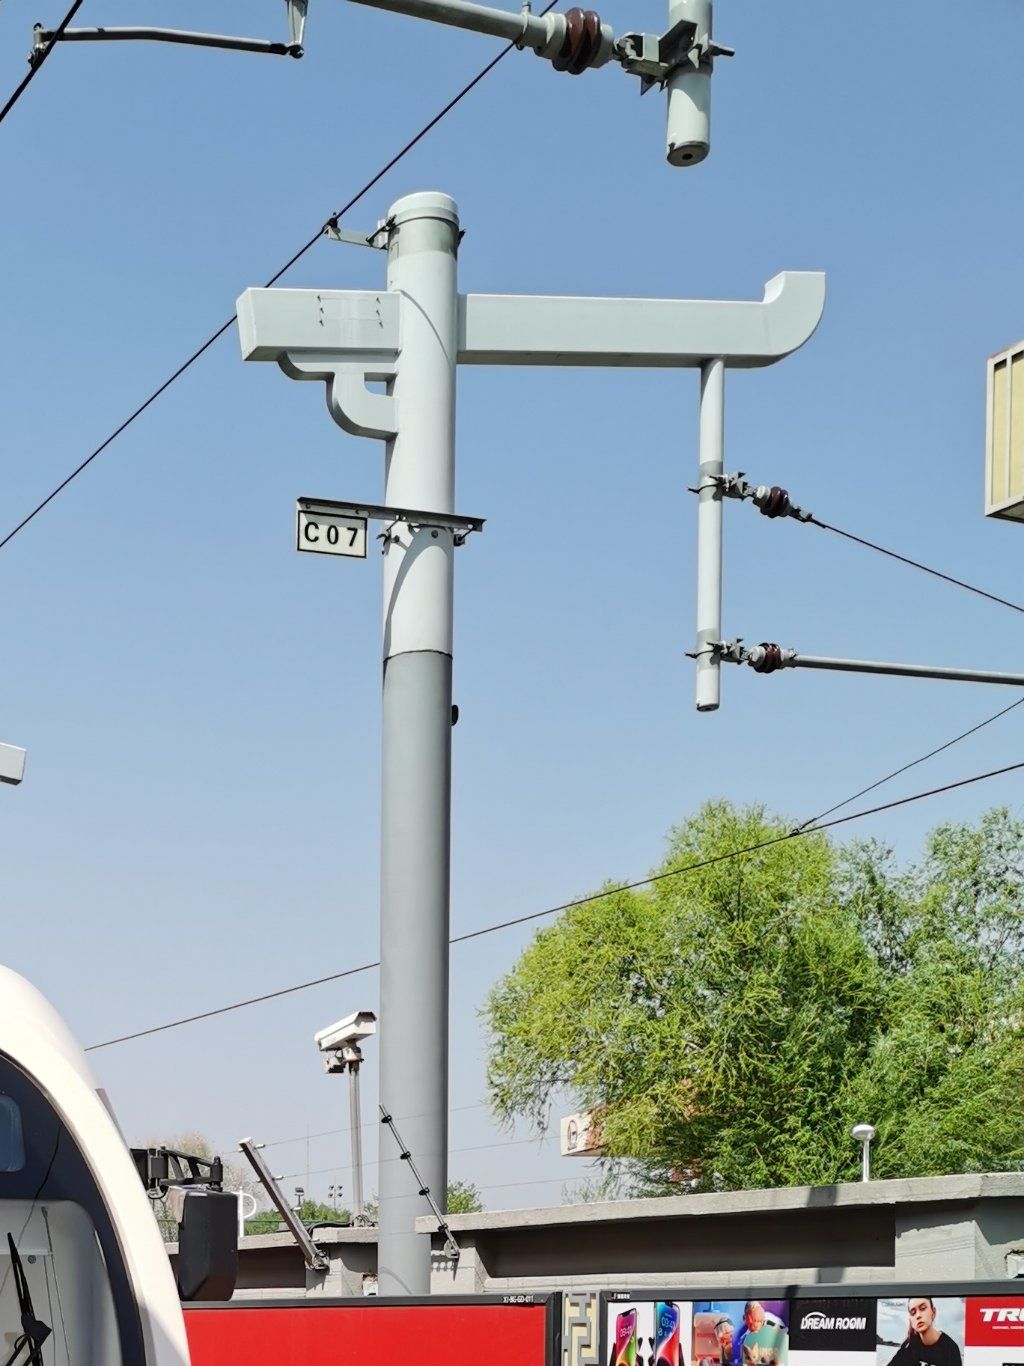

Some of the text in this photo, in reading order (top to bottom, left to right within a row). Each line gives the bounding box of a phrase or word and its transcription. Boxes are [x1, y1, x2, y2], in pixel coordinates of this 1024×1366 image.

[304, 521, 360, 547] C07
[800, 1314, 867, 1330] DREAM ROOM
